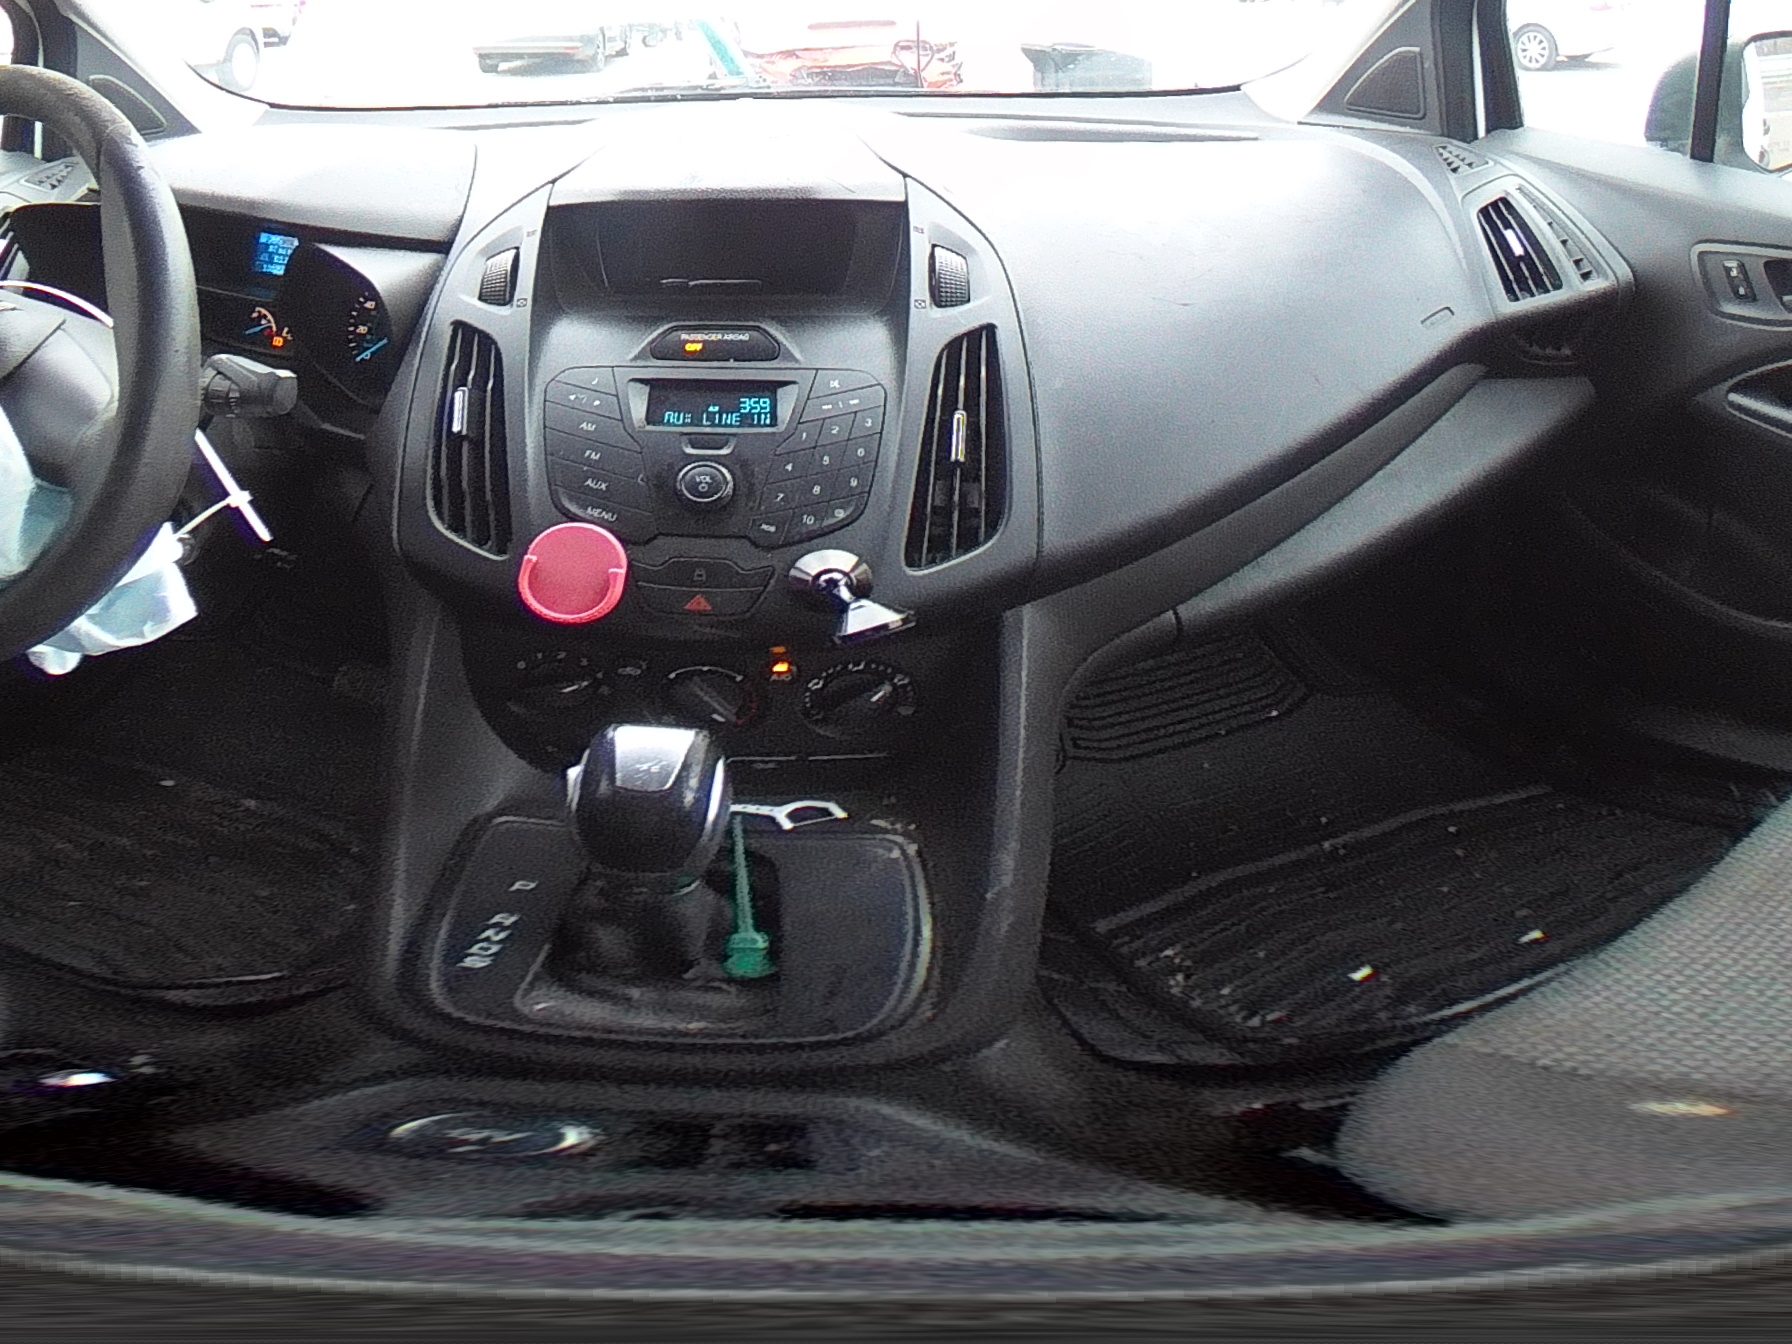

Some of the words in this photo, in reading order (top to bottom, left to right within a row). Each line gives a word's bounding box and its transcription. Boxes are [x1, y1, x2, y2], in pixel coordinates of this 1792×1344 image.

[702, 412, 741, 425] LINE
[753, 412, 771, 425] IN
[578, 421, 596, 431] AM
[584, 449, 602, 460] FM
[584, 478, 608, 491] AUX
[695, 475, 712, 483] VOL
[586, 506, 618, 522] MENU
